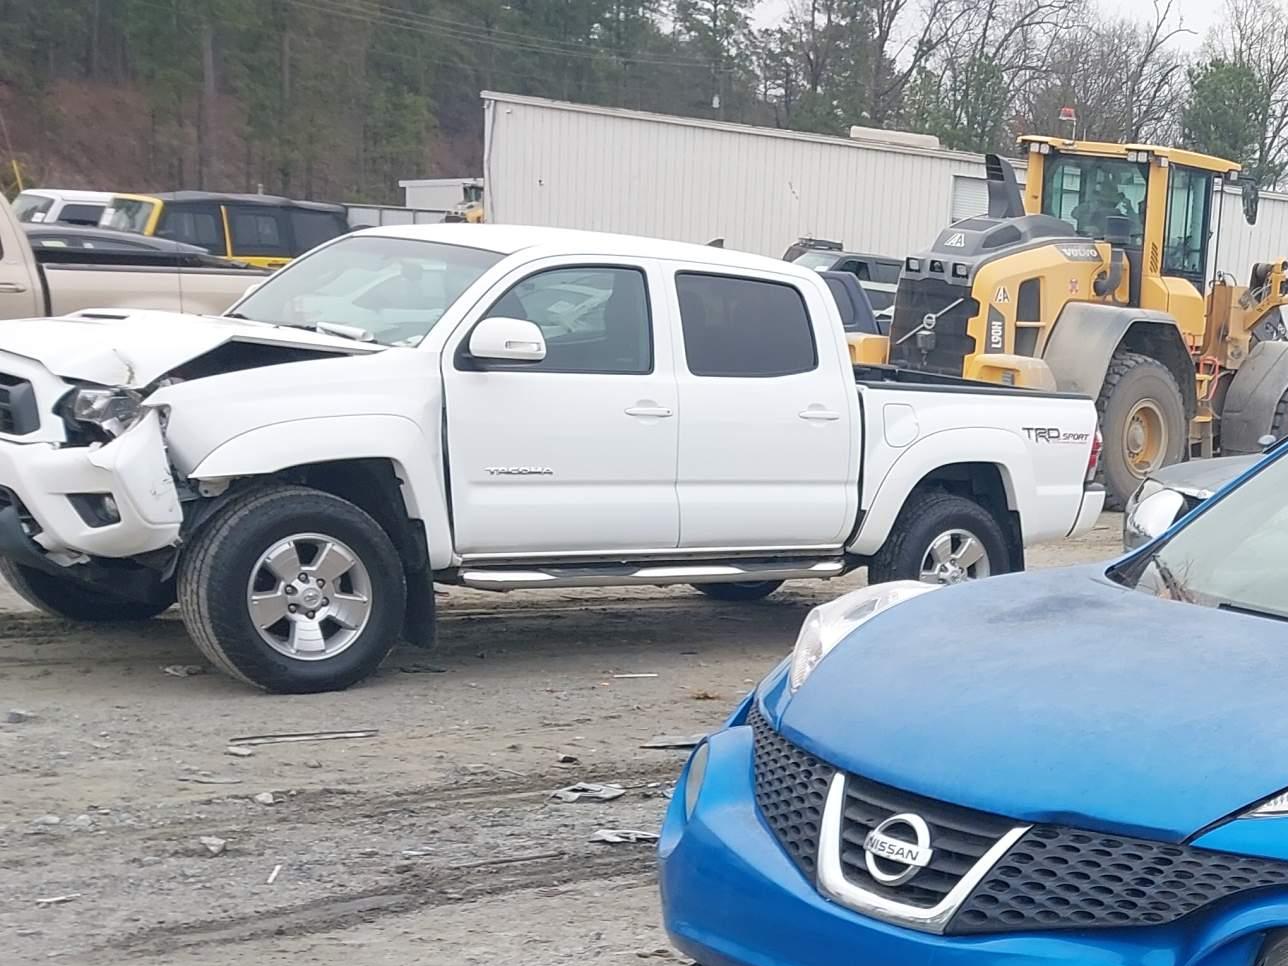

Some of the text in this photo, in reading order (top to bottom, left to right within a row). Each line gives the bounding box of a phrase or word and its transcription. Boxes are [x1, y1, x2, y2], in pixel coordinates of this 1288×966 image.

[1062, 248, 1098, 258] VOLVO
[991, 321, 1003, 349] L90H
[1021, 426, 1089, 443] TRD SPORT
[484, 466, 553, 476] TACOMA
[865, 834, 920, 862] NISSAN
